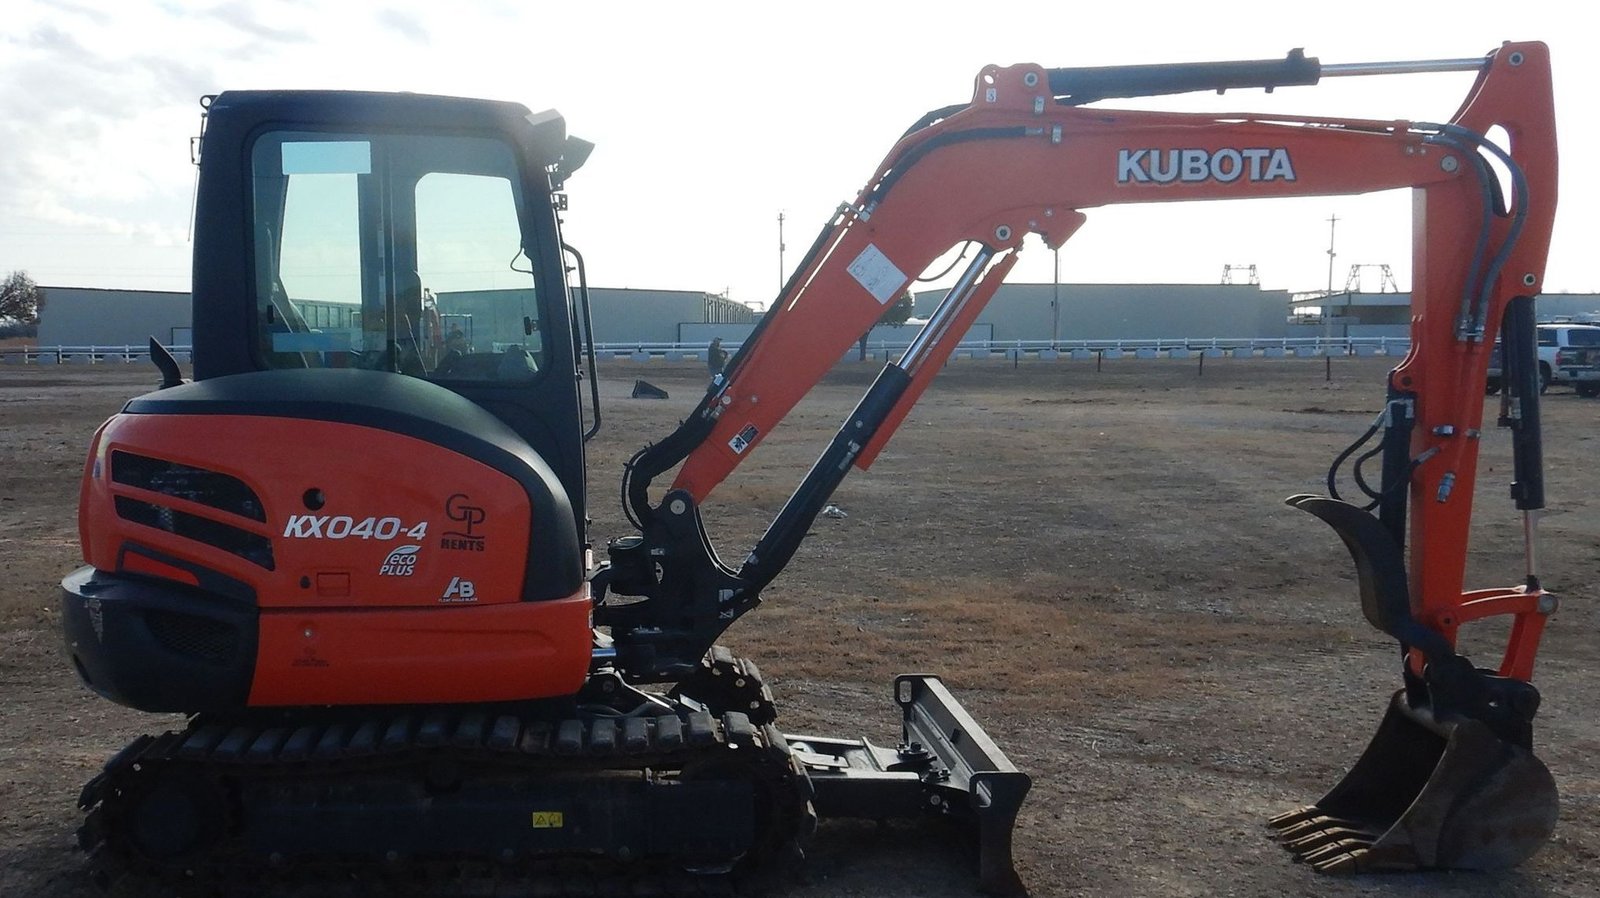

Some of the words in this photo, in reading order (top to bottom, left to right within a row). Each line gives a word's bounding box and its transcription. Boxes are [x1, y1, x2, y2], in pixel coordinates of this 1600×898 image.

[1117, 147, 1296, 183] KUBOTA
[283, 514, 428, 541] KX040-4
[441, 538, 485, 551] RENTS
[390, 554, 417, 565] eco
[379, 565, 414, 576] PLUS
[443, 576, 475, 598] AB
